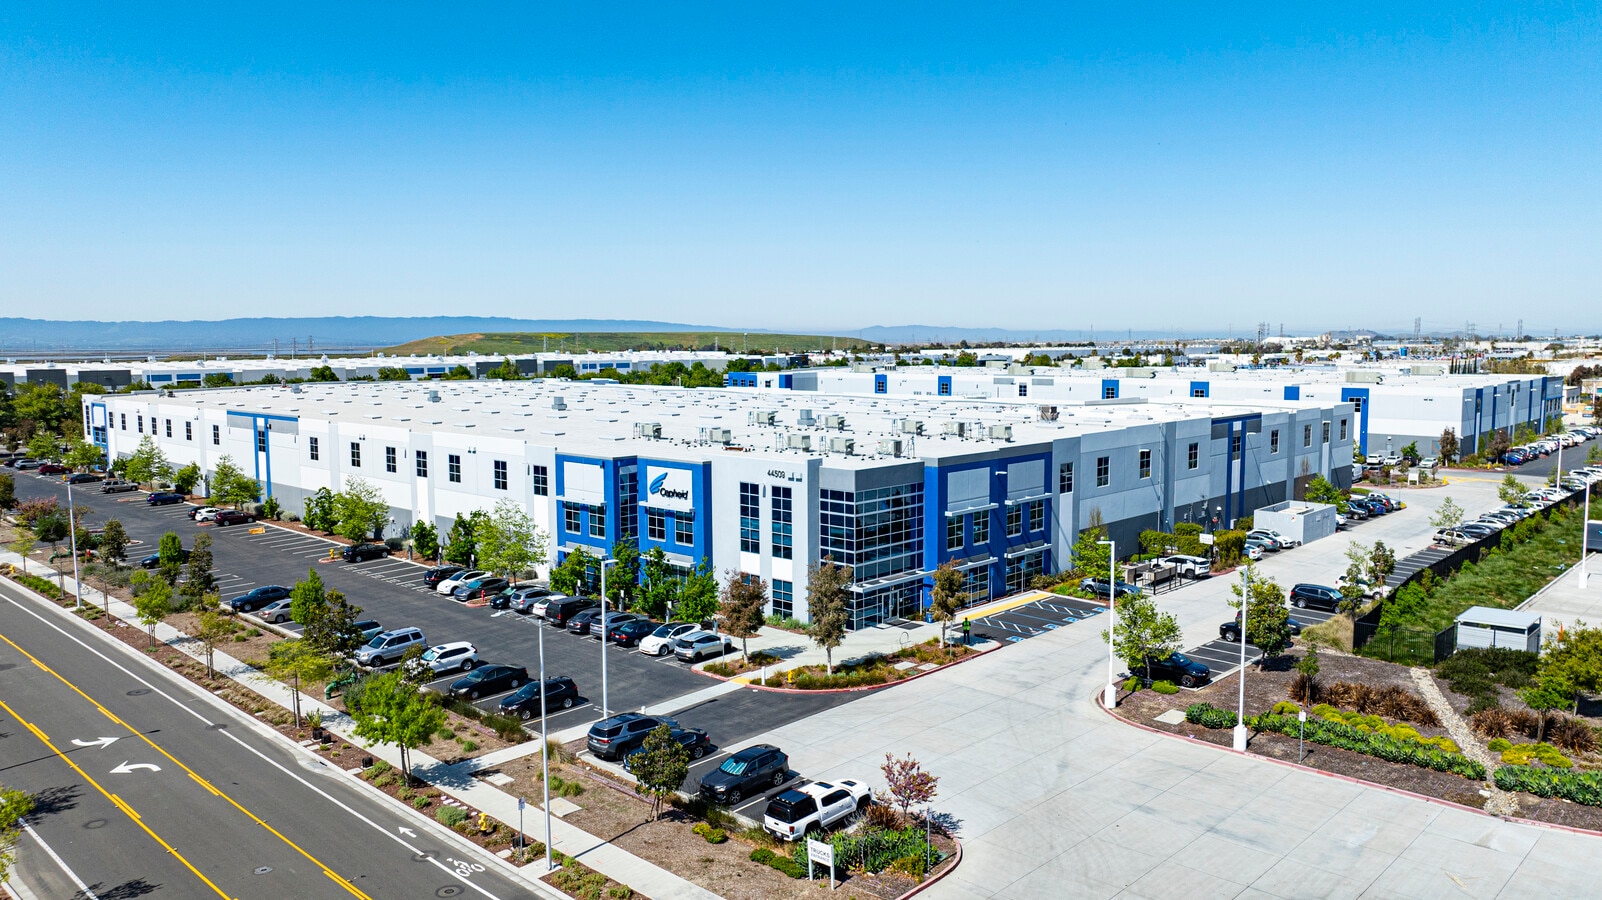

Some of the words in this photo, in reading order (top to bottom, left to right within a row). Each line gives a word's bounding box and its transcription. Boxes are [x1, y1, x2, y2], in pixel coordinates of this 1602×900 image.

[767, 469, 786, 479] 44509
[660, 487, 689, 501] Cepheid
[810, 846, 831, 858] TRUCKS
